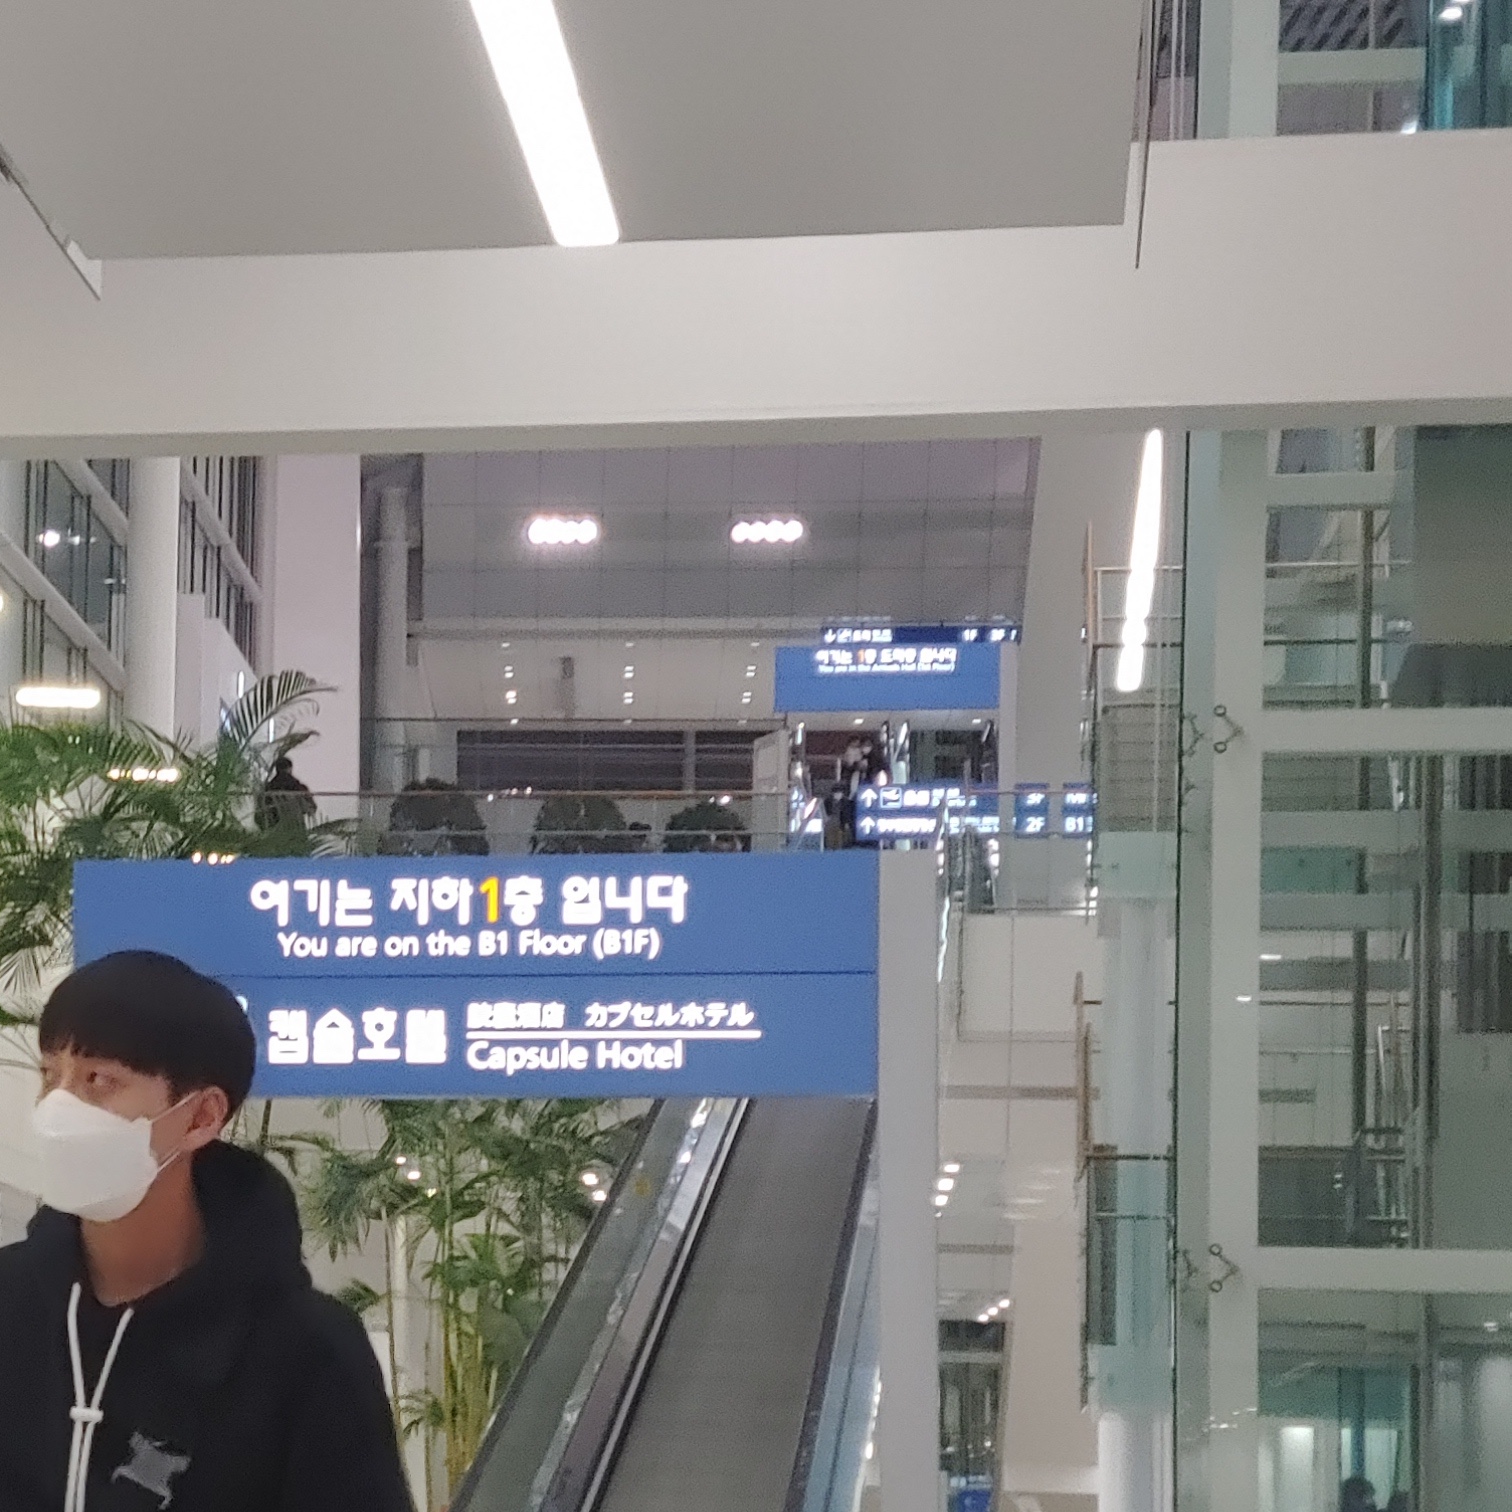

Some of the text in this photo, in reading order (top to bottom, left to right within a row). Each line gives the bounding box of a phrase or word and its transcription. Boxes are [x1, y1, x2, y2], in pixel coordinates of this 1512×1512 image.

[249, 875, 689, 928] 여기는 지하1층 입니다
[277, 927, 661, 960] You are on the B1 Floor (B1F)
[584, 1001, 756, 1028] カプセルホテル
[268, 1006, 447, 1064] 캡슐호텔
[466, 1039, 683, 1077] Capsule Hotel
